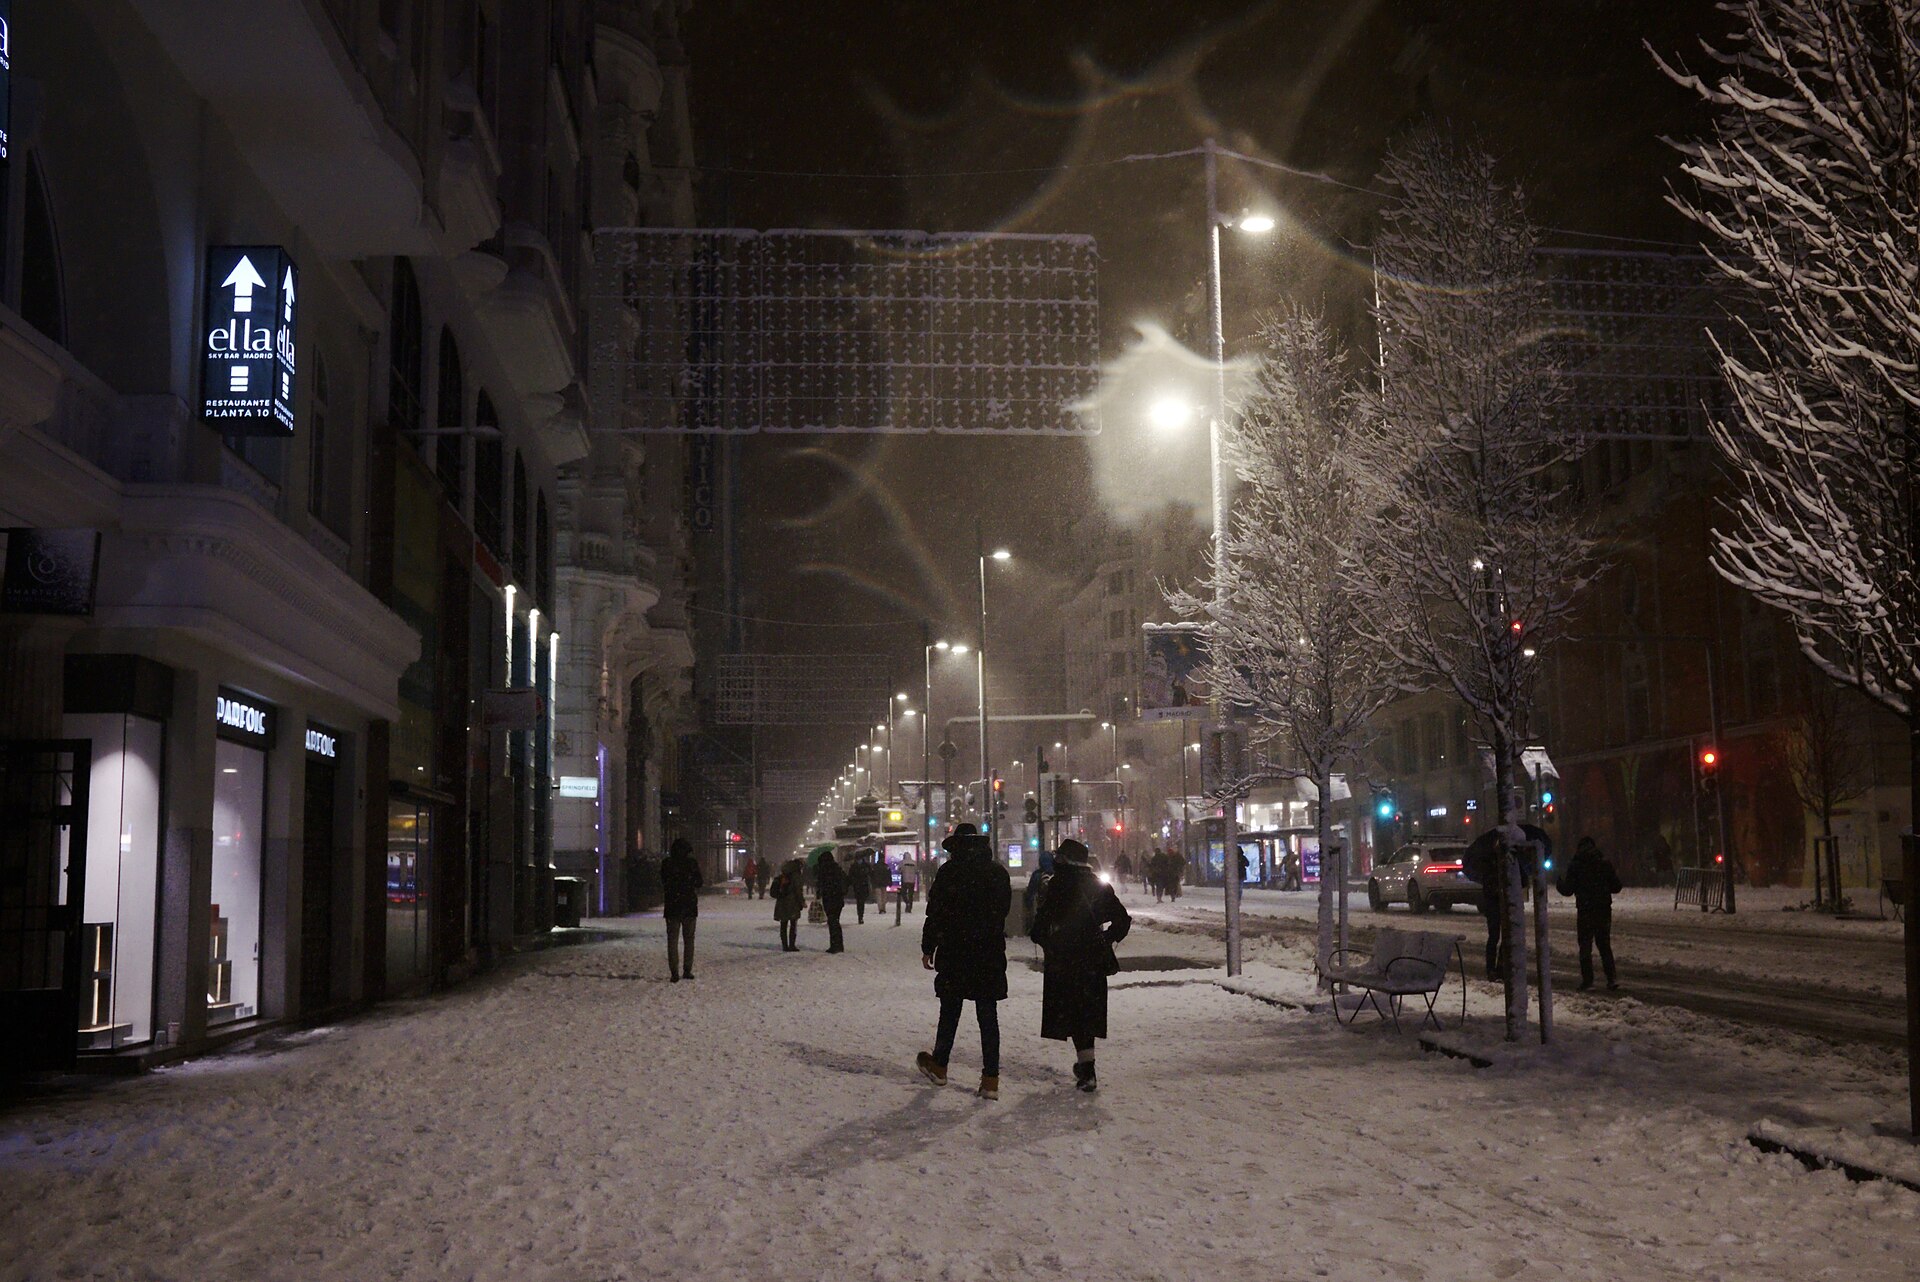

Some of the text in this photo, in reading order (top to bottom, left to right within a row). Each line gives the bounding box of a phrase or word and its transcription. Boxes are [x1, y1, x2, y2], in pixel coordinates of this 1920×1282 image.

[208, 318, 273, 351] ella
[206, 399, 270, 407] RESTAURANTE
[205, 409, 270, 417] PLANTA 10
[305, 728, 336, 758] ARFOIS
